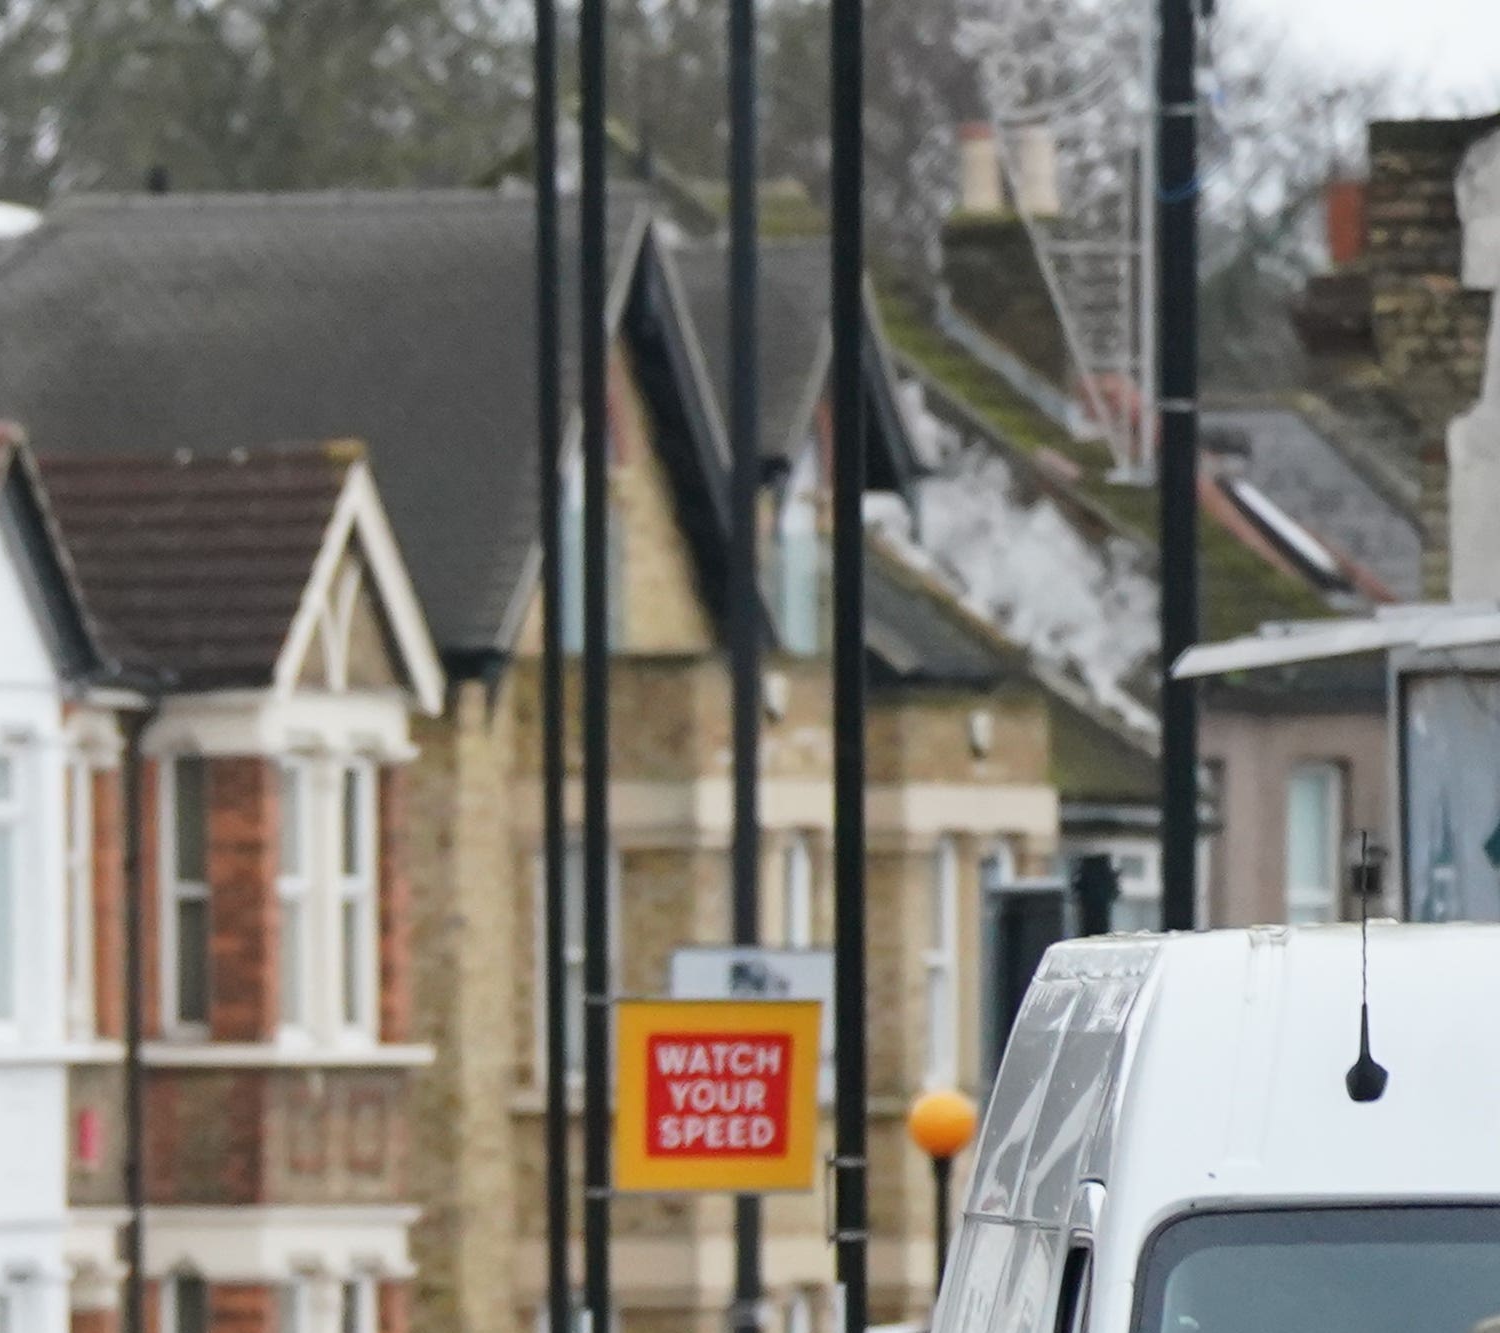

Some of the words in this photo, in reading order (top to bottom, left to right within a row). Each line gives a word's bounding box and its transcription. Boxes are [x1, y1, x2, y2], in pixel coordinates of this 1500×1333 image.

[655, 1042, 782, 1077] WATCH
[670, 1080, 767, 1114] YOUR
[659, 1115, 776, 1150] SPEED
